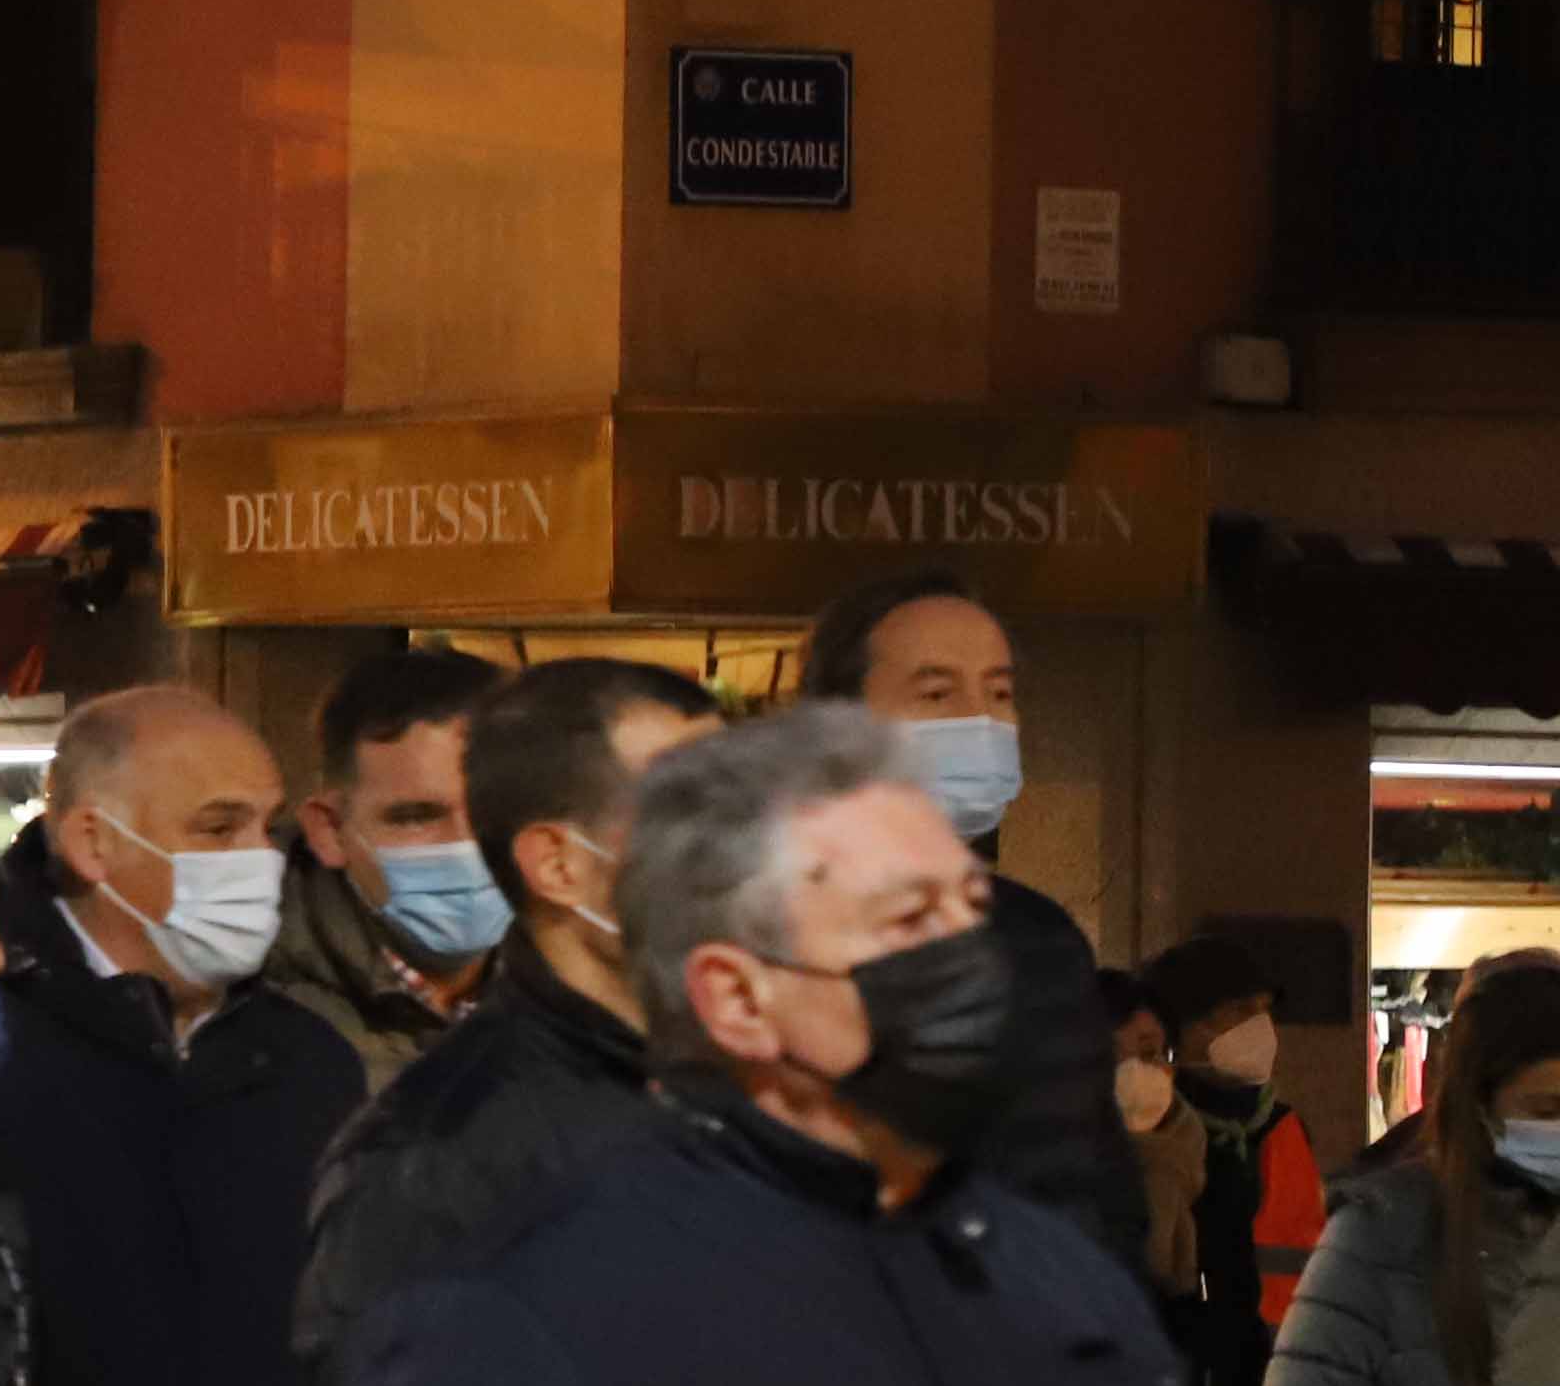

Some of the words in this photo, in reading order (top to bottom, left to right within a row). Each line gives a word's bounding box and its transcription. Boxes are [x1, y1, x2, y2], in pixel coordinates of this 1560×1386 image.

[741, 77, 816, 105] CALLE
[687, 137, 840, 169] CONDESTABLE
[225, 475, 553, 554] DELICATESSEN
[680, 476, 1134, 545] DELICATESSEN
